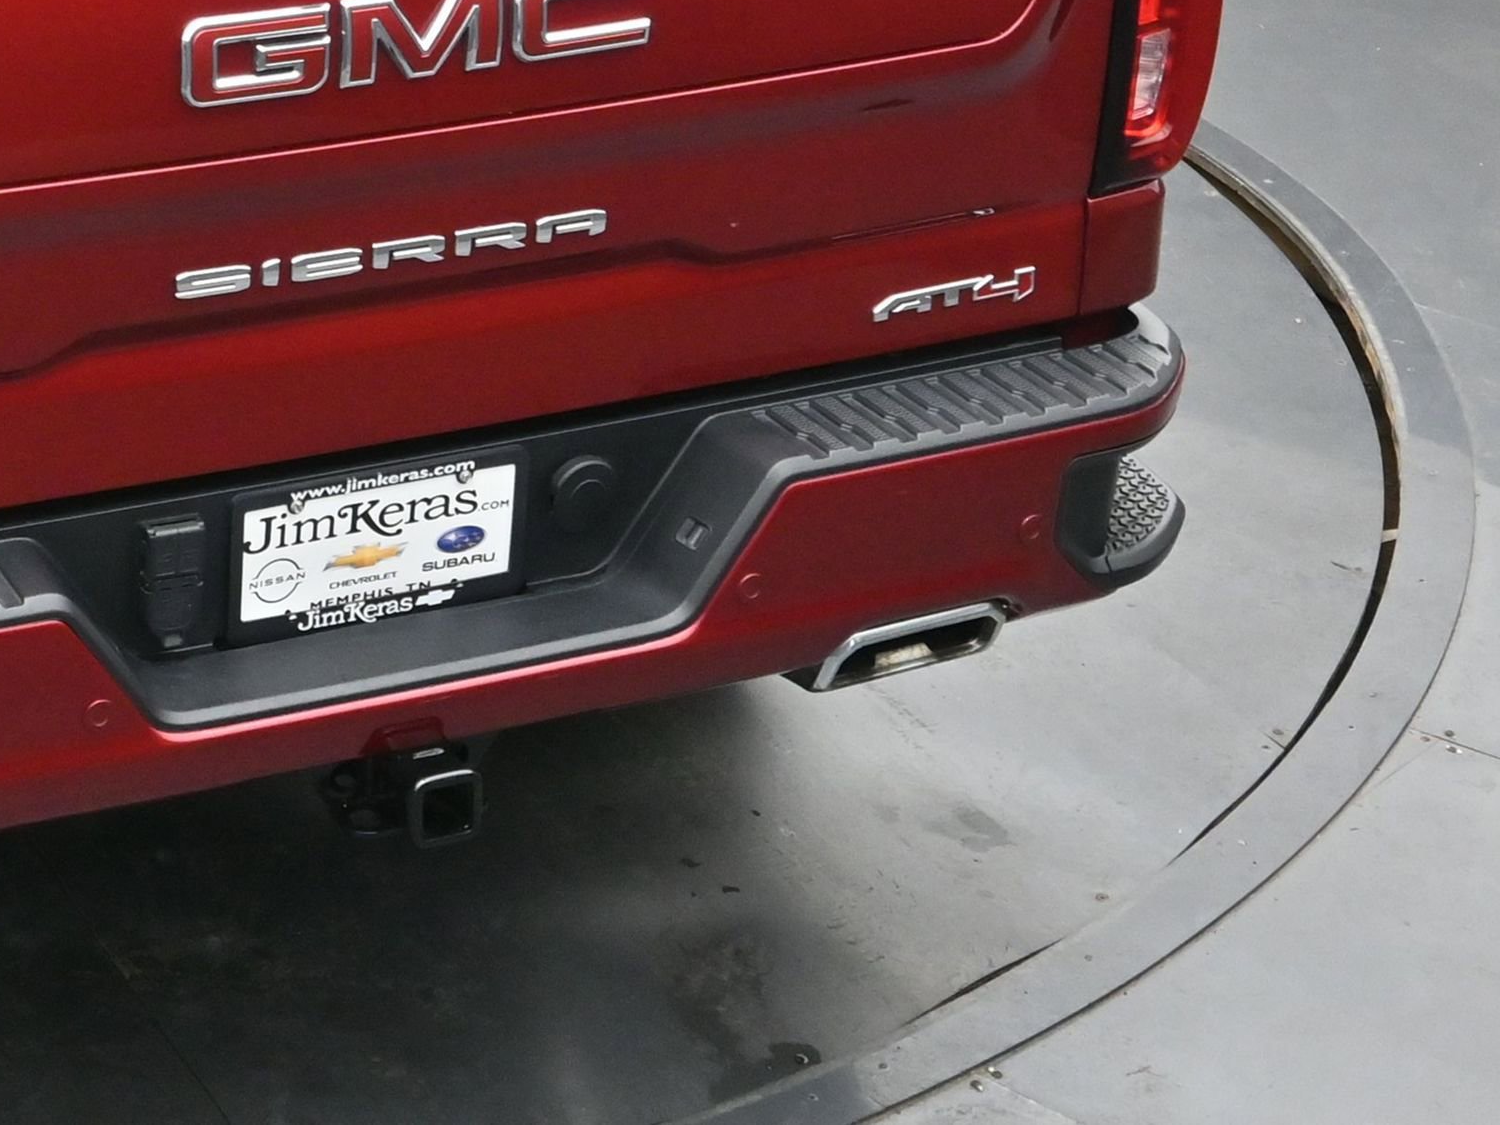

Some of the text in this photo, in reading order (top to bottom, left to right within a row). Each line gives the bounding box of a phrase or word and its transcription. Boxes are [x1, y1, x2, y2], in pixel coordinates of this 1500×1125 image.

[175, 209, 607, 299] SIERRA
[872, 266, 1036, 322] AT4
[290, 460, 475, 500] www.jimkeras.com
[422, 552, 496, 572] SUBARU
[249, 571, 306, 590] NISSAN
[310, 580, 431, 610] MEMPHIS TN
[328, 571, 397, 590] CHEVROLET
